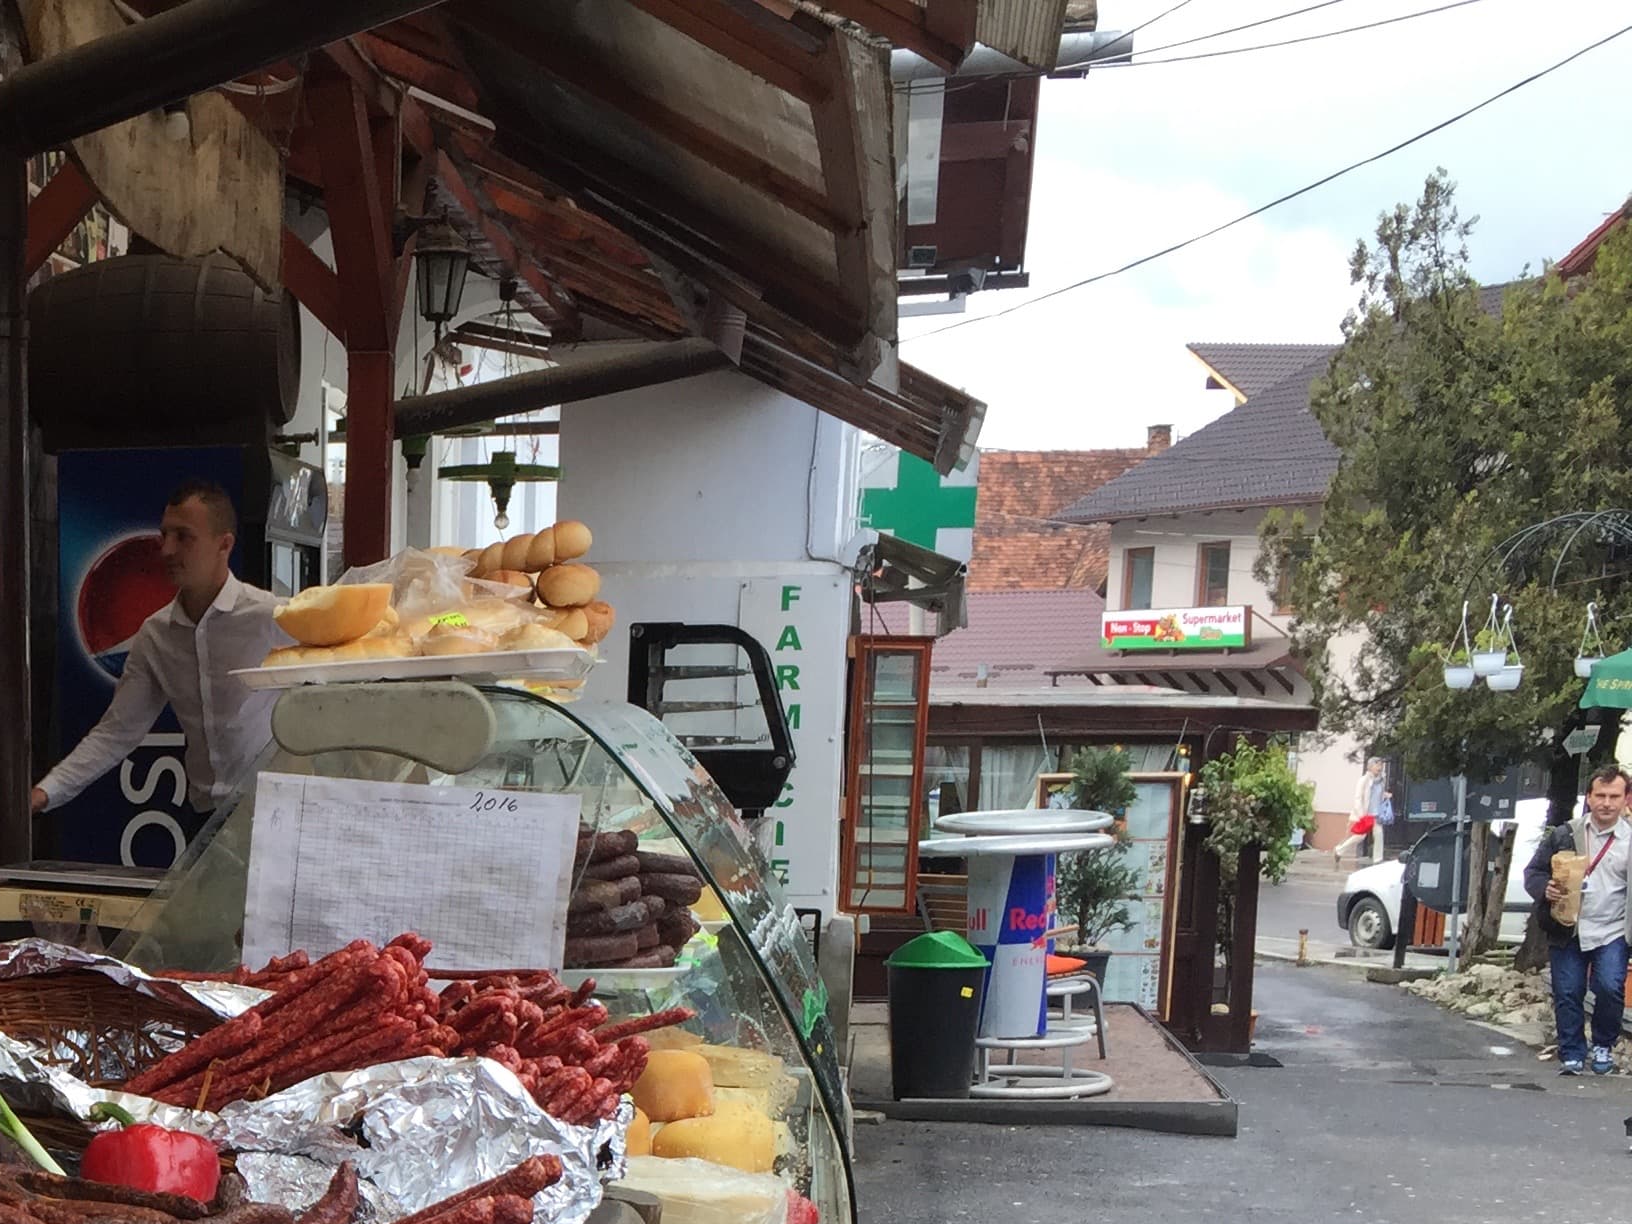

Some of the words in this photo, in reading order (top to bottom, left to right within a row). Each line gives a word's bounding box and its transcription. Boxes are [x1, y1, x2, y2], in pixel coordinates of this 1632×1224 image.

[1182, 611, 1241, 626] Supermarket
[771, 584, 803, 888] FARMCIE
[469, 791, 519, 813] 2016
[968, 907, 987, 930] ull
